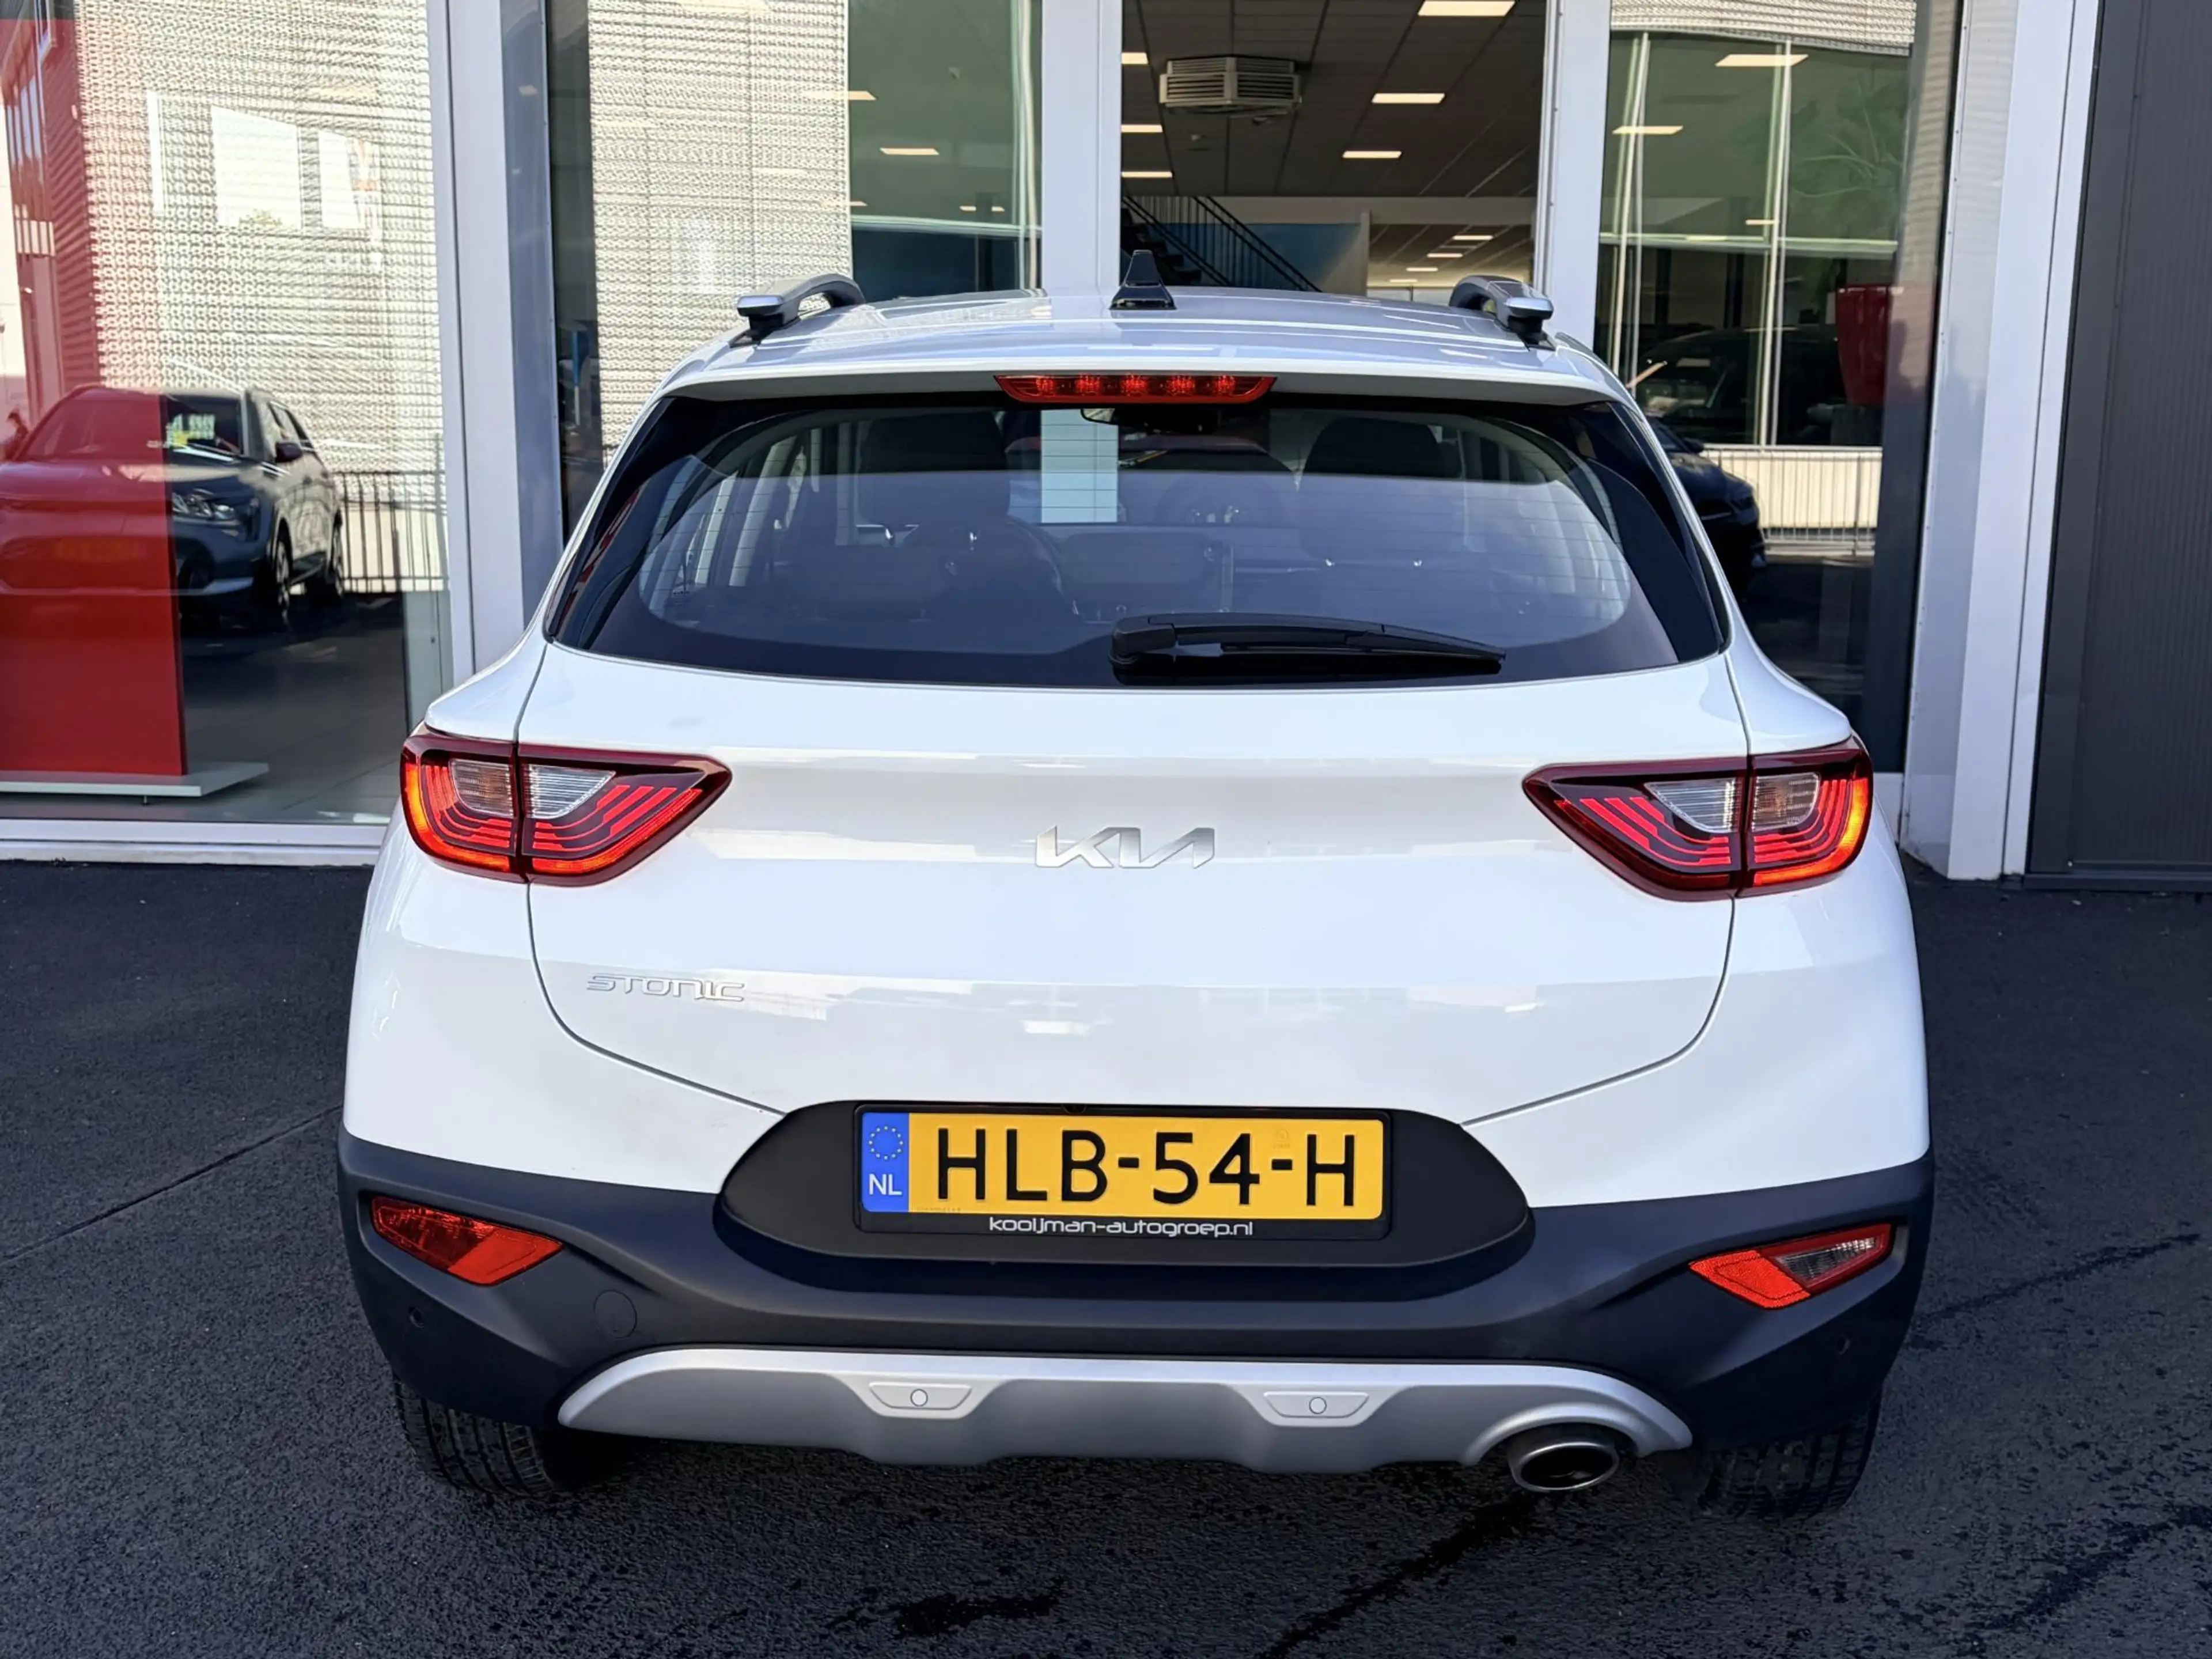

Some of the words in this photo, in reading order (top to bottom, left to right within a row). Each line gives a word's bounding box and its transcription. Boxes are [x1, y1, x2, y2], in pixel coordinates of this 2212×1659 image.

[1035, 824, 1215, 869] KIA
[586, 972, 745, 1002] STONIC
[938, 1127, 1355, 1206] HLB-54-H
[869, 1173, 903, 1196] NL
[989, 1216, 1253, 1238] kooijman-autogroep.nl
